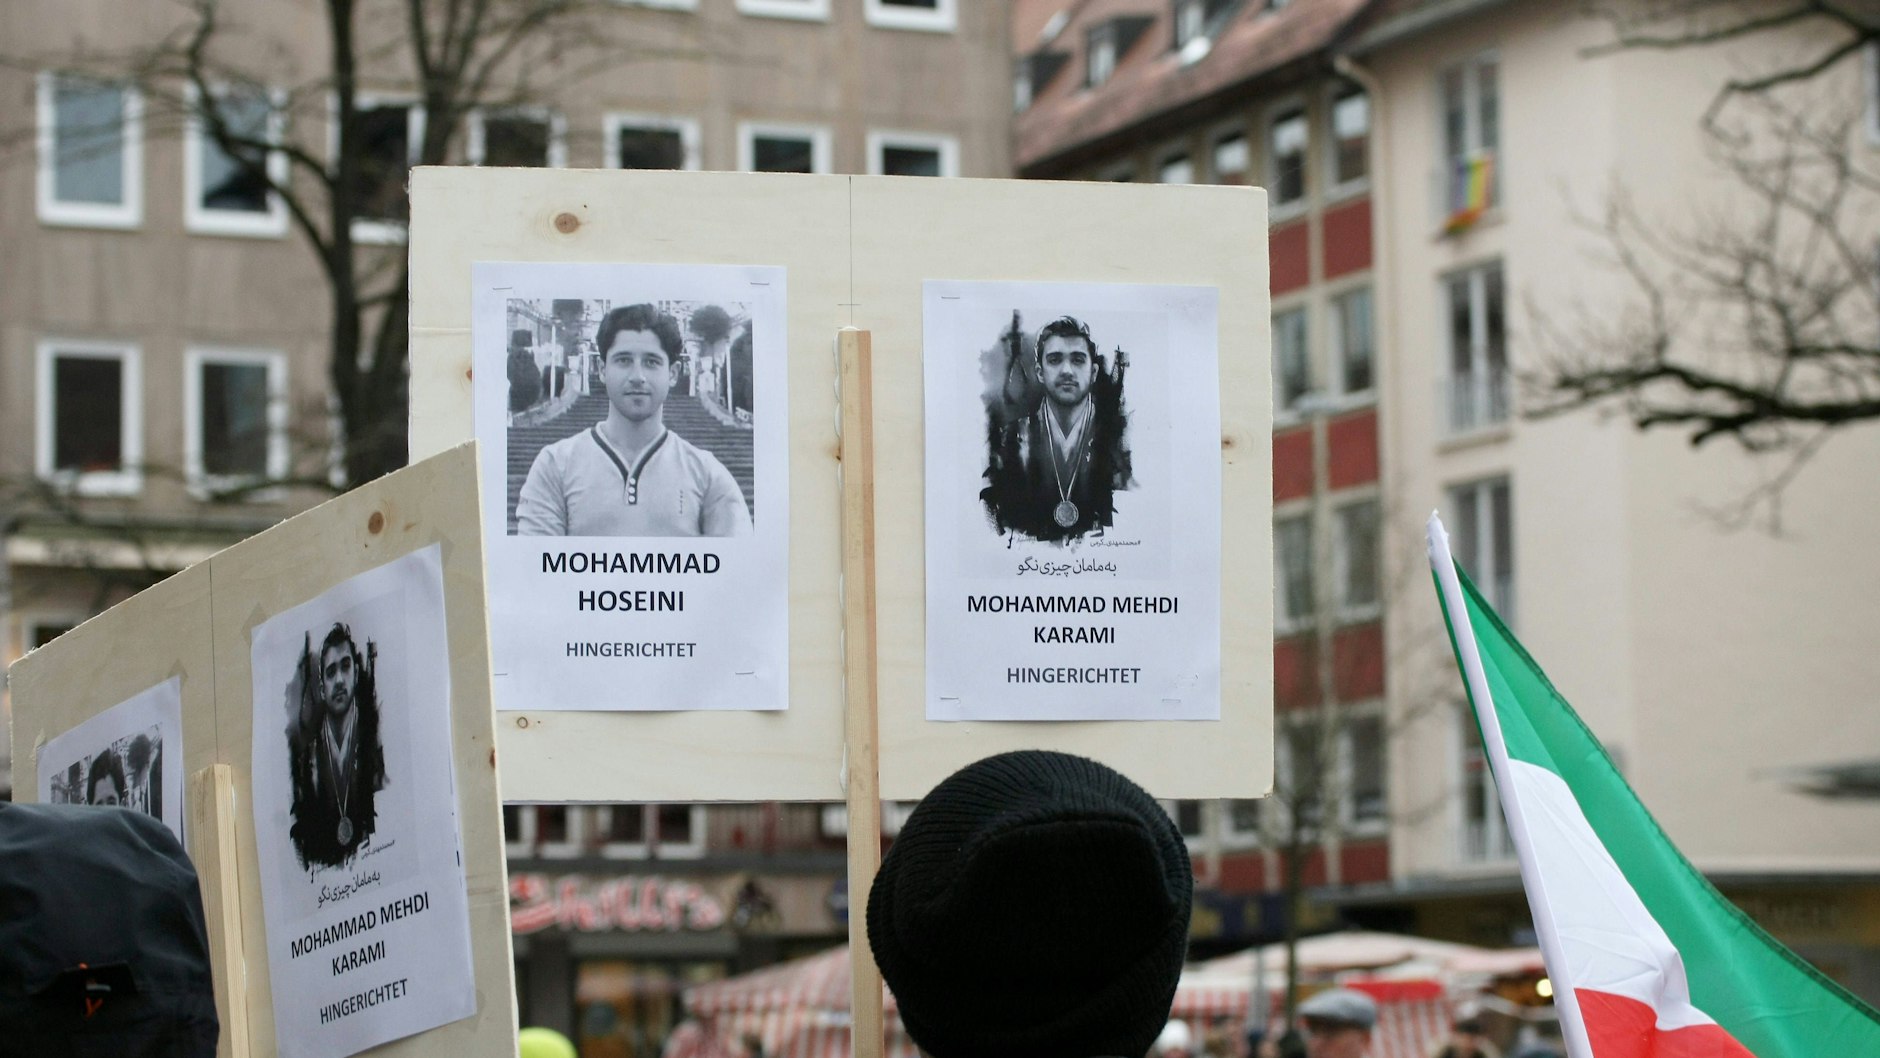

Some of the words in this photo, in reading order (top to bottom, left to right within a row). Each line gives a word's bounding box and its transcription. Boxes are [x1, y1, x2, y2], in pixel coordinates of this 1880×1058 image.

[542, 552, 721, 574] MOHAMMAD
[578, 590, 684, 612] HOSEINI
[967, 595, 1106, 614] MOHAMMAD
[1112, 596, 1178, 614] MEHDI
[1034, 626, 1115, 644] KARAMI
[566, 642, 697, 658] HINGERICHTET
[1007, 667, 1142, 684] HINGERICHTET
[291, 910, 376, 959] MOHAMMAD
[381, 891, 430, 925] MEHDI
[332, 940, 386, 976] KARAMI
[320, 978, 408, 1025] HINGERICHTET
